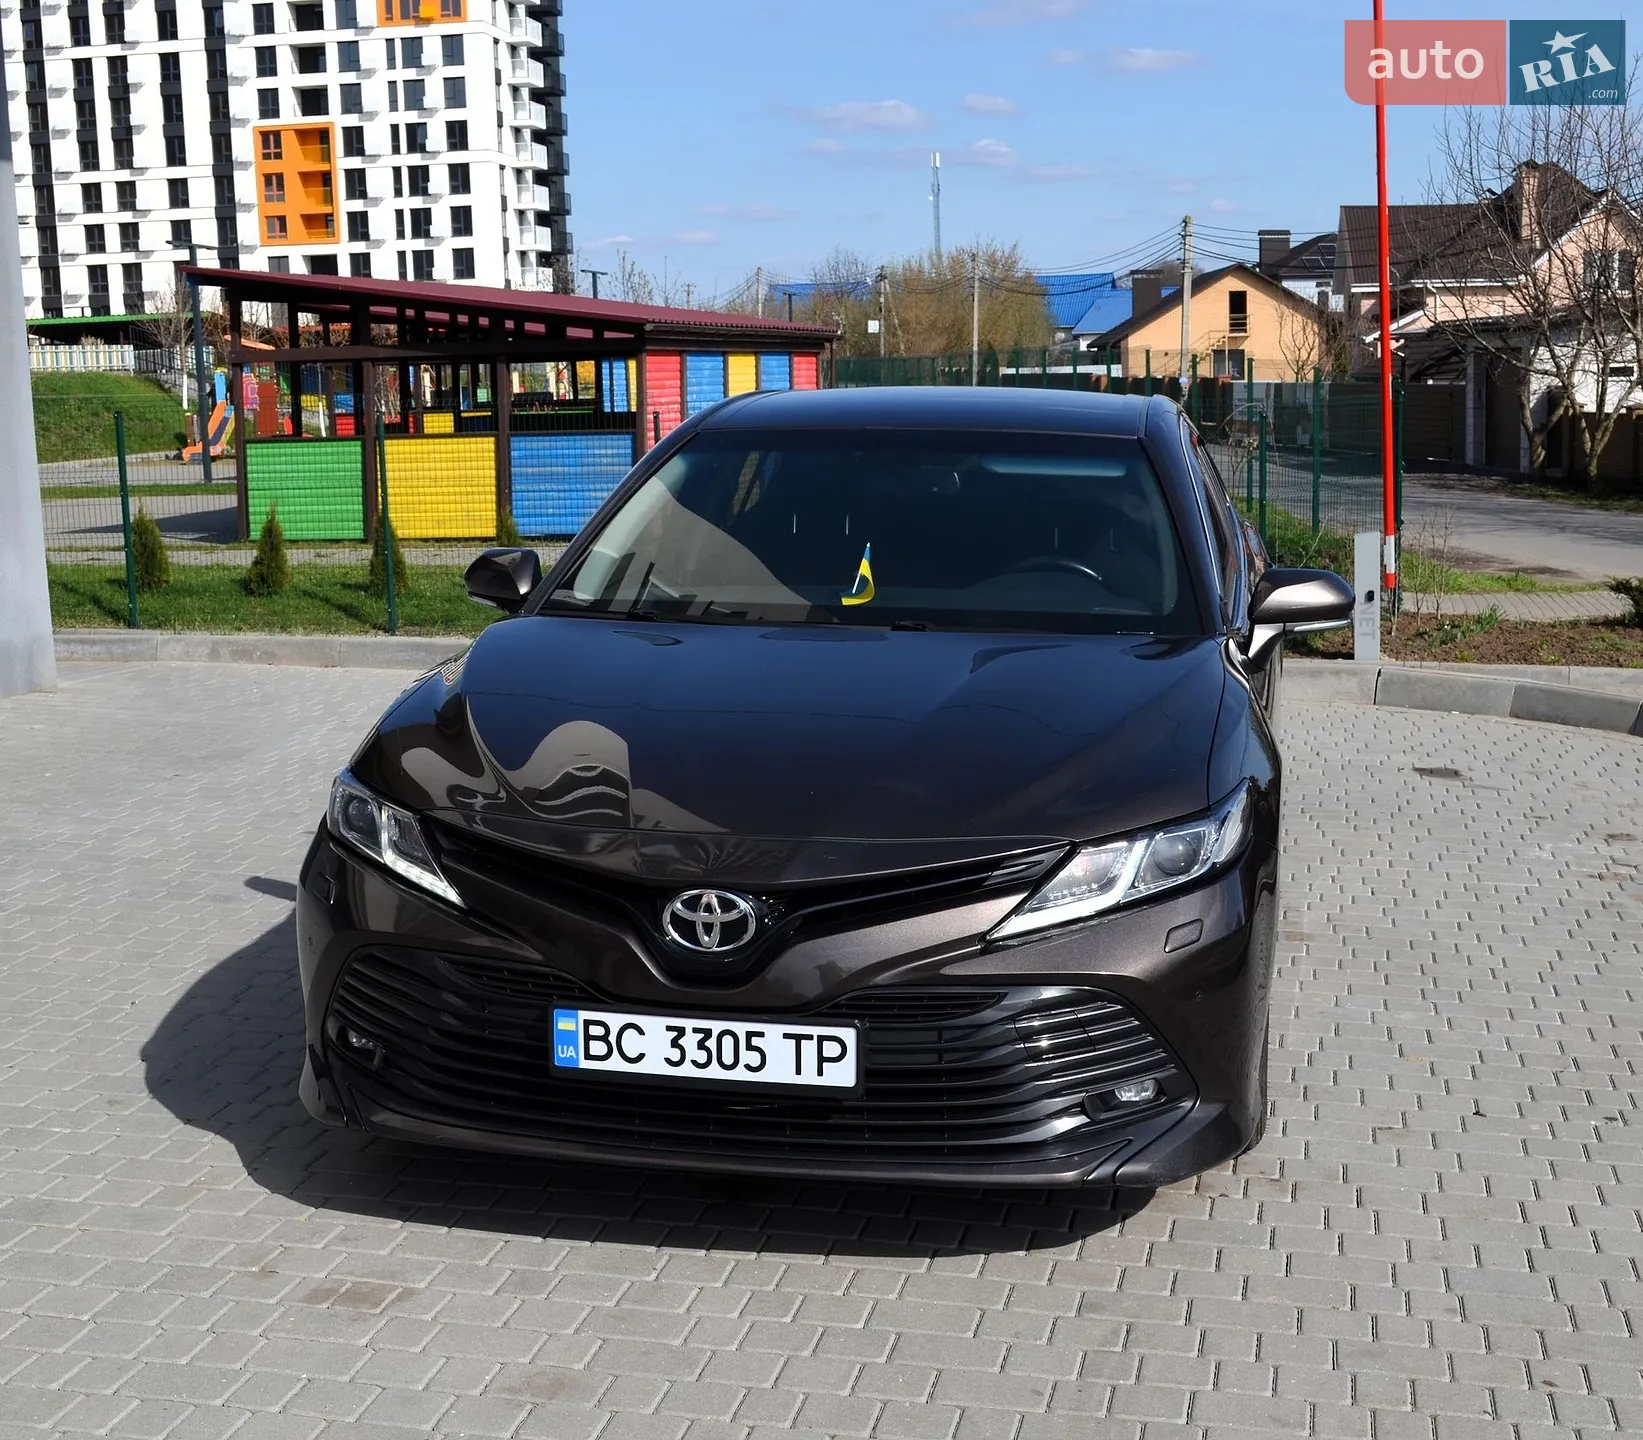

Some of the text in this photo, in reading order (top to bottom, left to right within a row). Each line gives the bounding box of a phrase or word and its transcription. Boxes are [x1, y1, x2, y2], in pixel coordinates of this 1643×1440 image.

[558, 1044, 576, 1059] UA
[583, 1019, 848, 1077] BC 3305 TP
